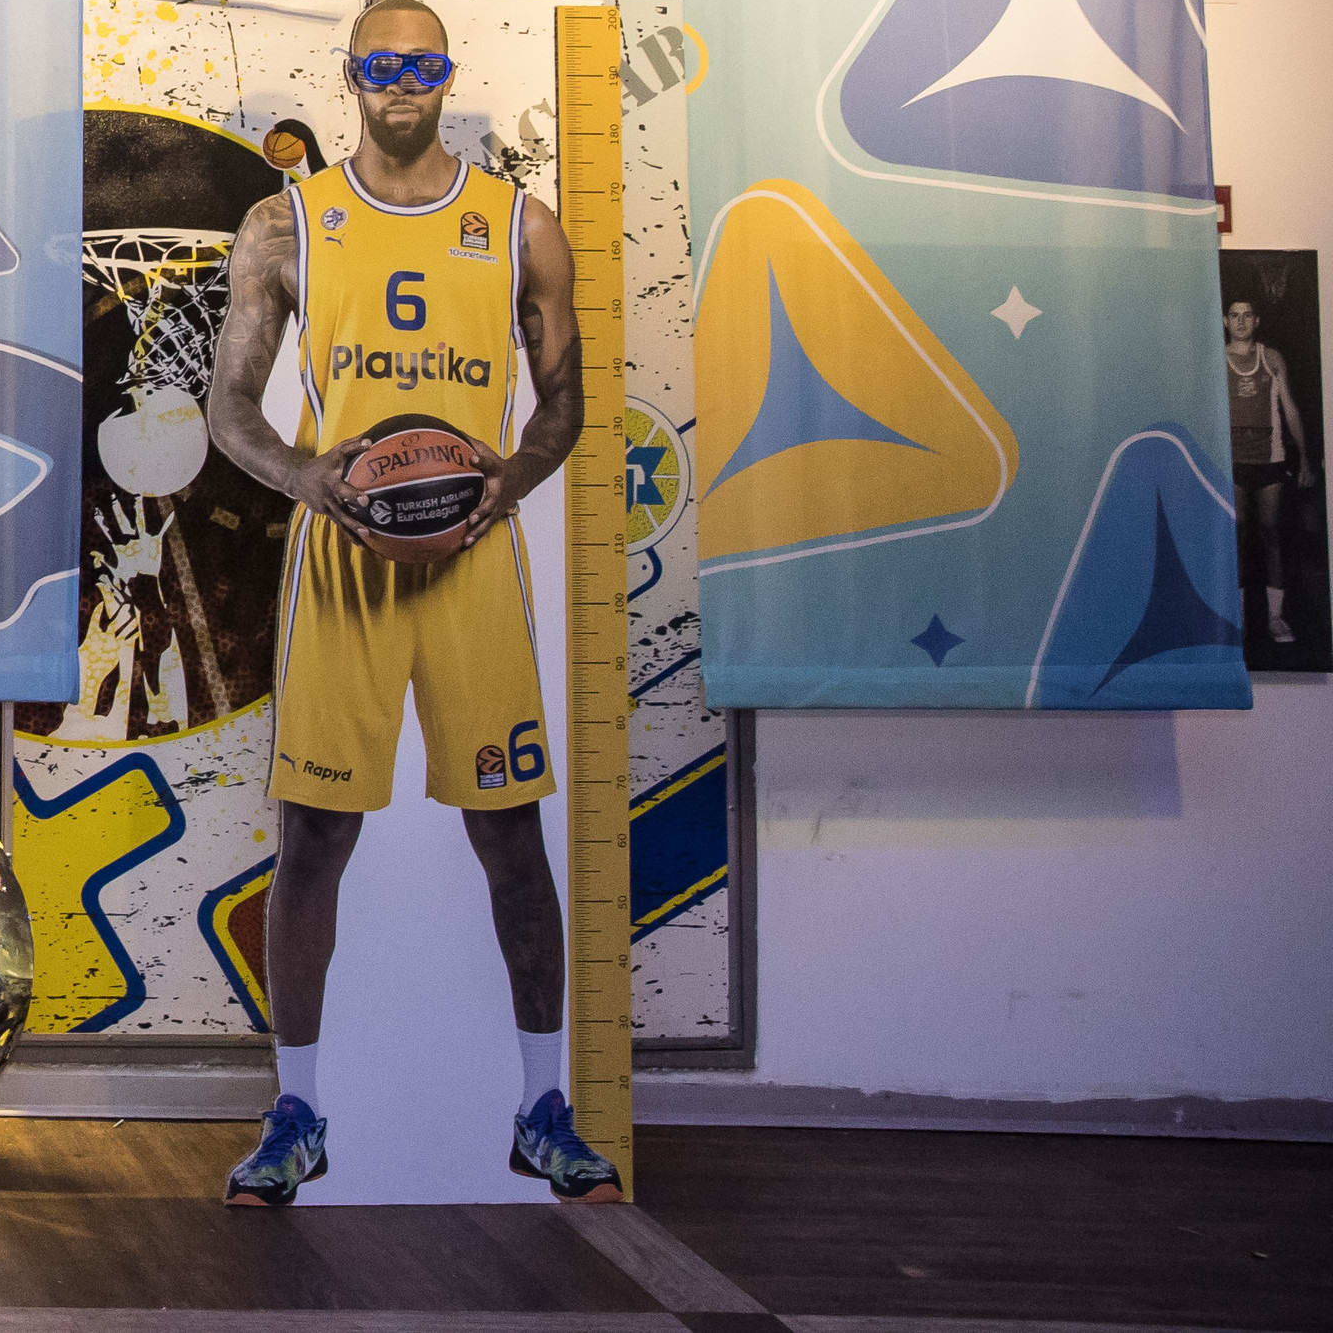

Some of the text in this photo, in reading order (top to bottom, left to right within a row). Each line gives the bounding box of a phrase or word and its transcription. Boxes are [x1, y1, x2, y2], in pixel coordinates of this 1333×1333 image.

[607, 9, 618, 31] 200
[608, 65, 619, 88] 190
[609, 123, 620, 146] 180
[610, 181, 621, 203] 170
[611, 240, 621, 263] 160
[386, 270, 426, 331] 6
[612, 298, 622, 321] 150
[332, 341, 491, 390] Playtika
[612, 357, 623, 379] 140
[613, 416, 623, 439] 130
[367, 444, 465, 483] SPALDING
[613, 474, 624, 498] 120
[396, 497, 438, 511] TURKISH
[614, 533, 624, 555] 110
[614, 592, 625, 615] 100
[615, 655, 626, 672] 90
[616, 715, 626, 731] 80
[508, 719, 545, 783] 6
[303, 760, 353, 782] Rapyd
[616, 774, 626, 790] 70
[617, 833, 627, 848] 60
[617, 895, 627, 910] 50
[618, 954, 629, 969] 40
[618, 1015, 629, 1030] 30
[619, 1075, 630, 1090] 20
[620, 1136, 630, 1150] 10
